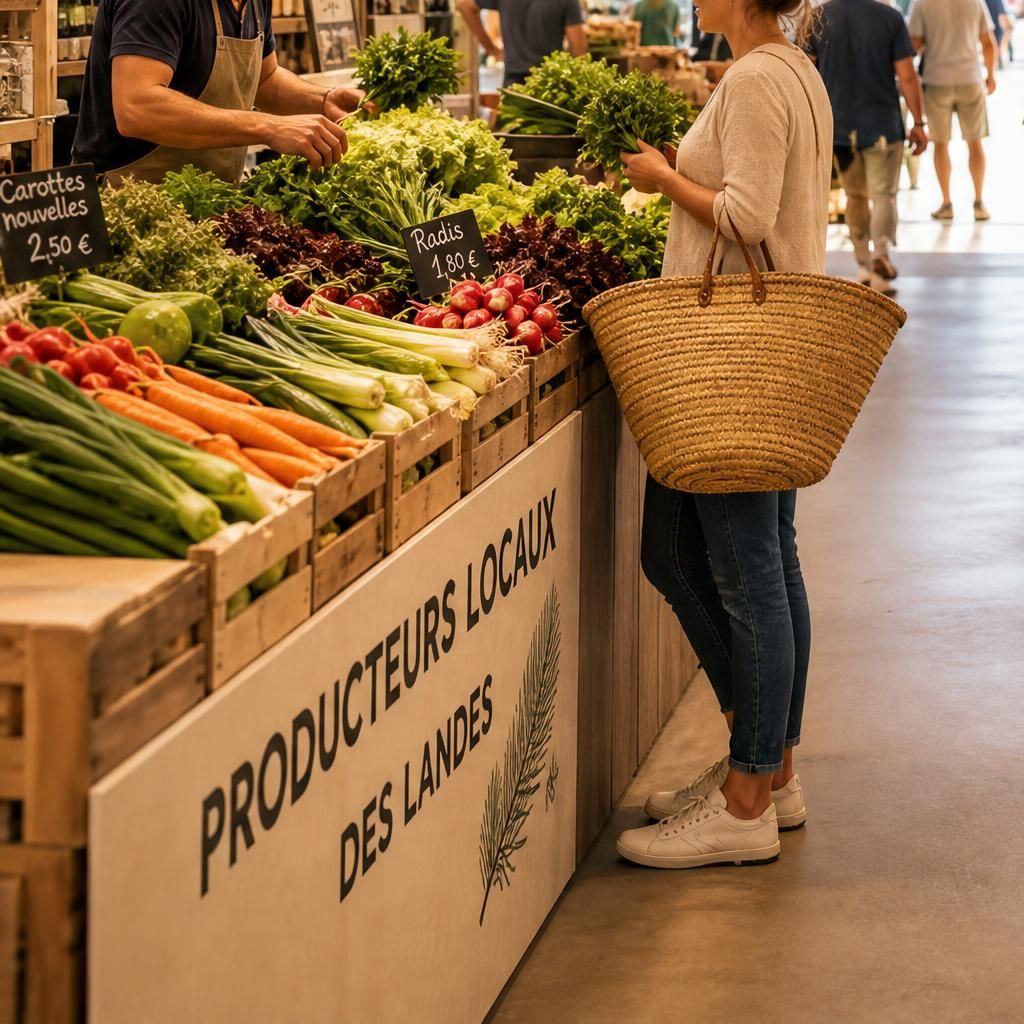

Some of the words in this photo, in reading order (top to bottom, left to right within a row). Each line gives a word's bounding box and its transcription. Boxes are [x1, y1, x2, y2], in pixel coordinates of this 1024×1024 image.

[0, 171, 86, 204] Carottes
[1, 196, 89, 232] nouvelles
[27, 232, 72, 265] 2,50
[77, 233, 93, 255] €
[410, 220, 464, 254] Radis
[431, 252, 465, 280] 1,80
[199, 578, 457, 899] PRODUCTEURS
[465, 487, 558, 632] LOCAUX
[339, 781, 393, 904] DES
[403, 673, 493, 827] LANDES
